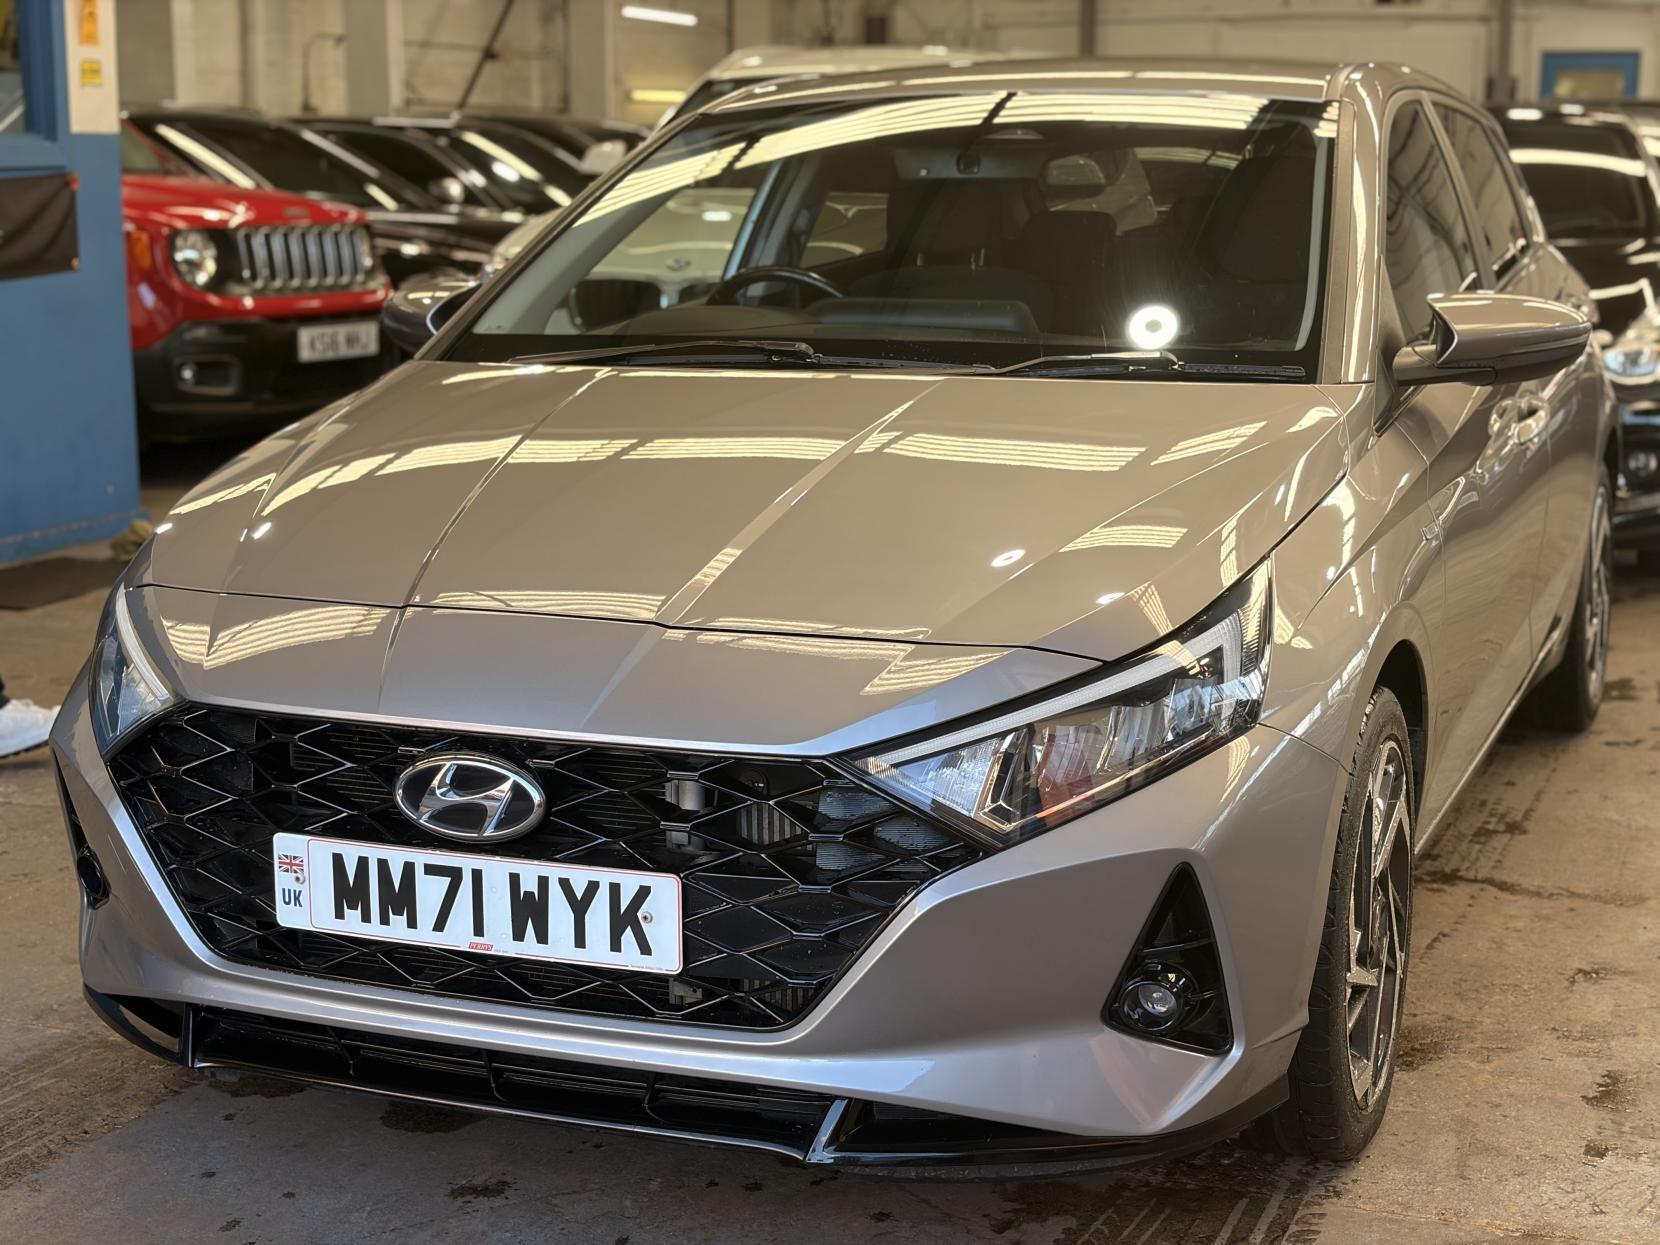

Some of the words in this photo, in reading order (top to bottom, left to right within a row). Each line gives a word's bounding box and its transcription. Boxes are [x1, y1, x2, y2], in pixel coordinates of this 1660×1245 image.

[282, 887, 303, 908] UK
[331, 852, 485, 938] MM71
[508, 871, 653, 956] WYK
